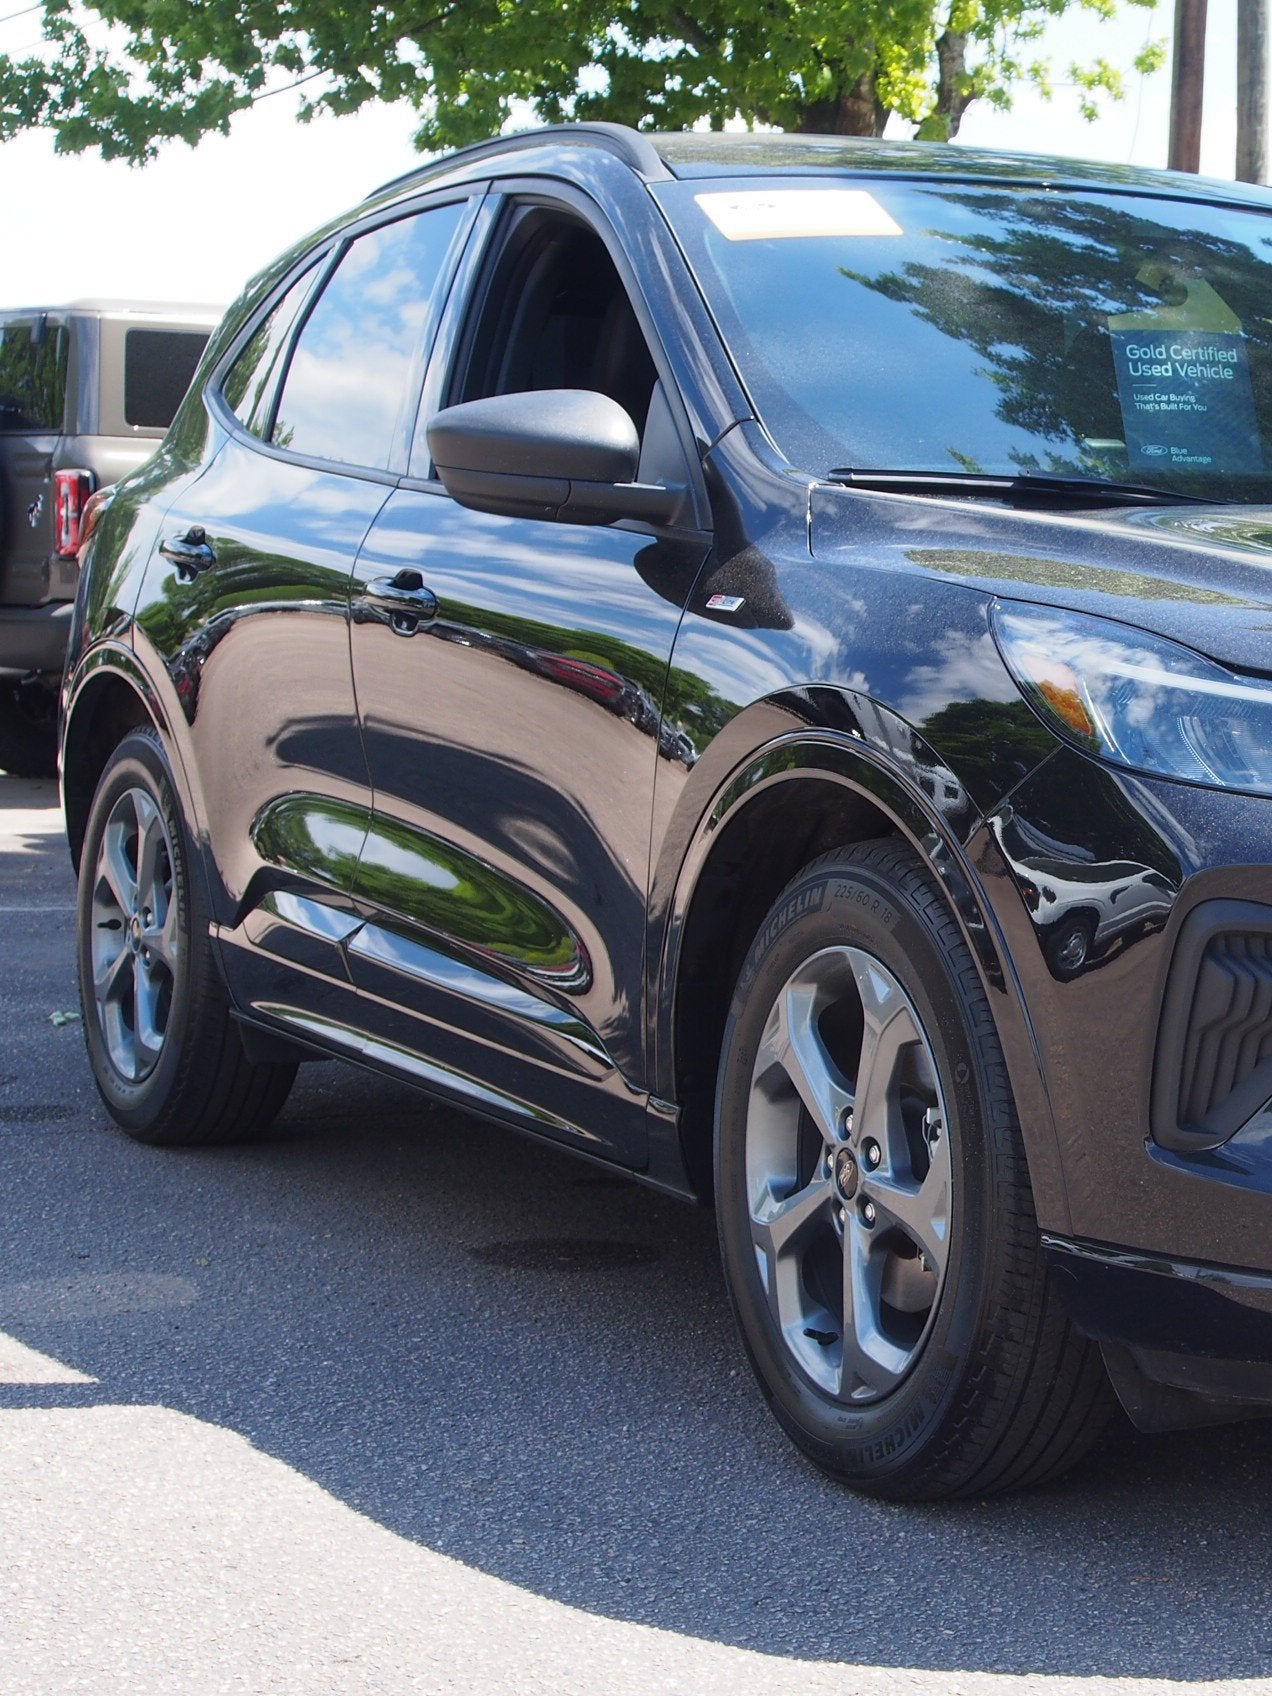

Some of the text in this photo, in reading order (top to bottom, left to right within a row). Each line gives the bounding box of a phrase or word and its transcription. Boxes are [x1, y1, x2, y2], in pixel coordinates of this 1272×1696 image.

[1125, 344, 1238, 363] Gold Certified
[1128, 361, 1234, 379] Used Vehicle
[1133, 393, 1196, 403] Used Car Buying
[1134, 402, 1160, 410] That's
[1160, 402, 1178, 410] Built
[1179, 403, 1191, 411] For
[1170, 446, 1188, 455] Blue
[1171, 455, 1212, 464] Advantage
[834, 884, 893, 924] 225/60 R 18
[754, 886, 823, 964] MICHELIN
